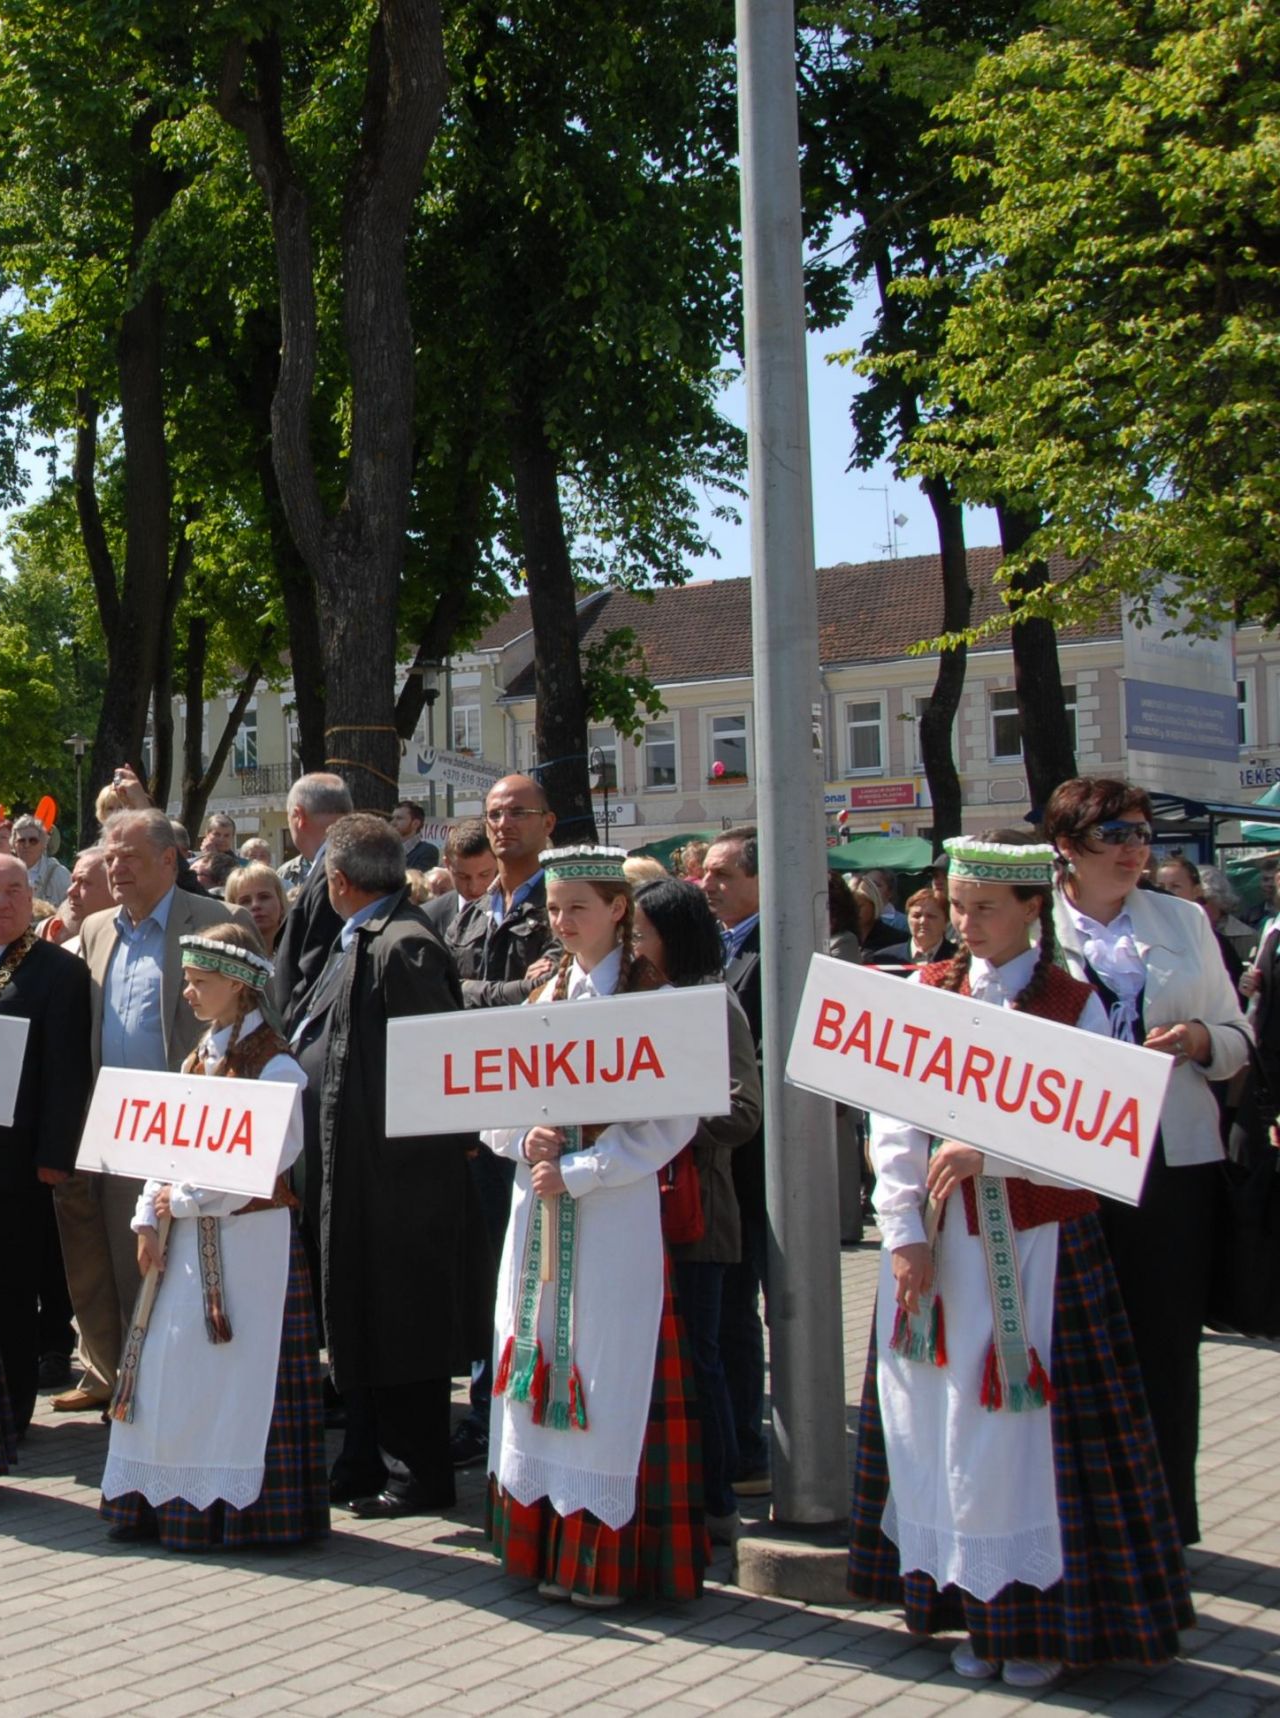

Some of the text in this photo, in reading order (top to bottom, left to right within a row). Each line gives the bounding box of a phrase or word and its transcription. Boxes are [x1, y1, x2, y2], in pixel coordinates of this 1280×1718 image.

[442, 1035, 665, 1096] LENKIJA
[811, 997, 1143, 1159] BALTARUSIJA
[114, 1098, 254, 1157] ITALIJA
